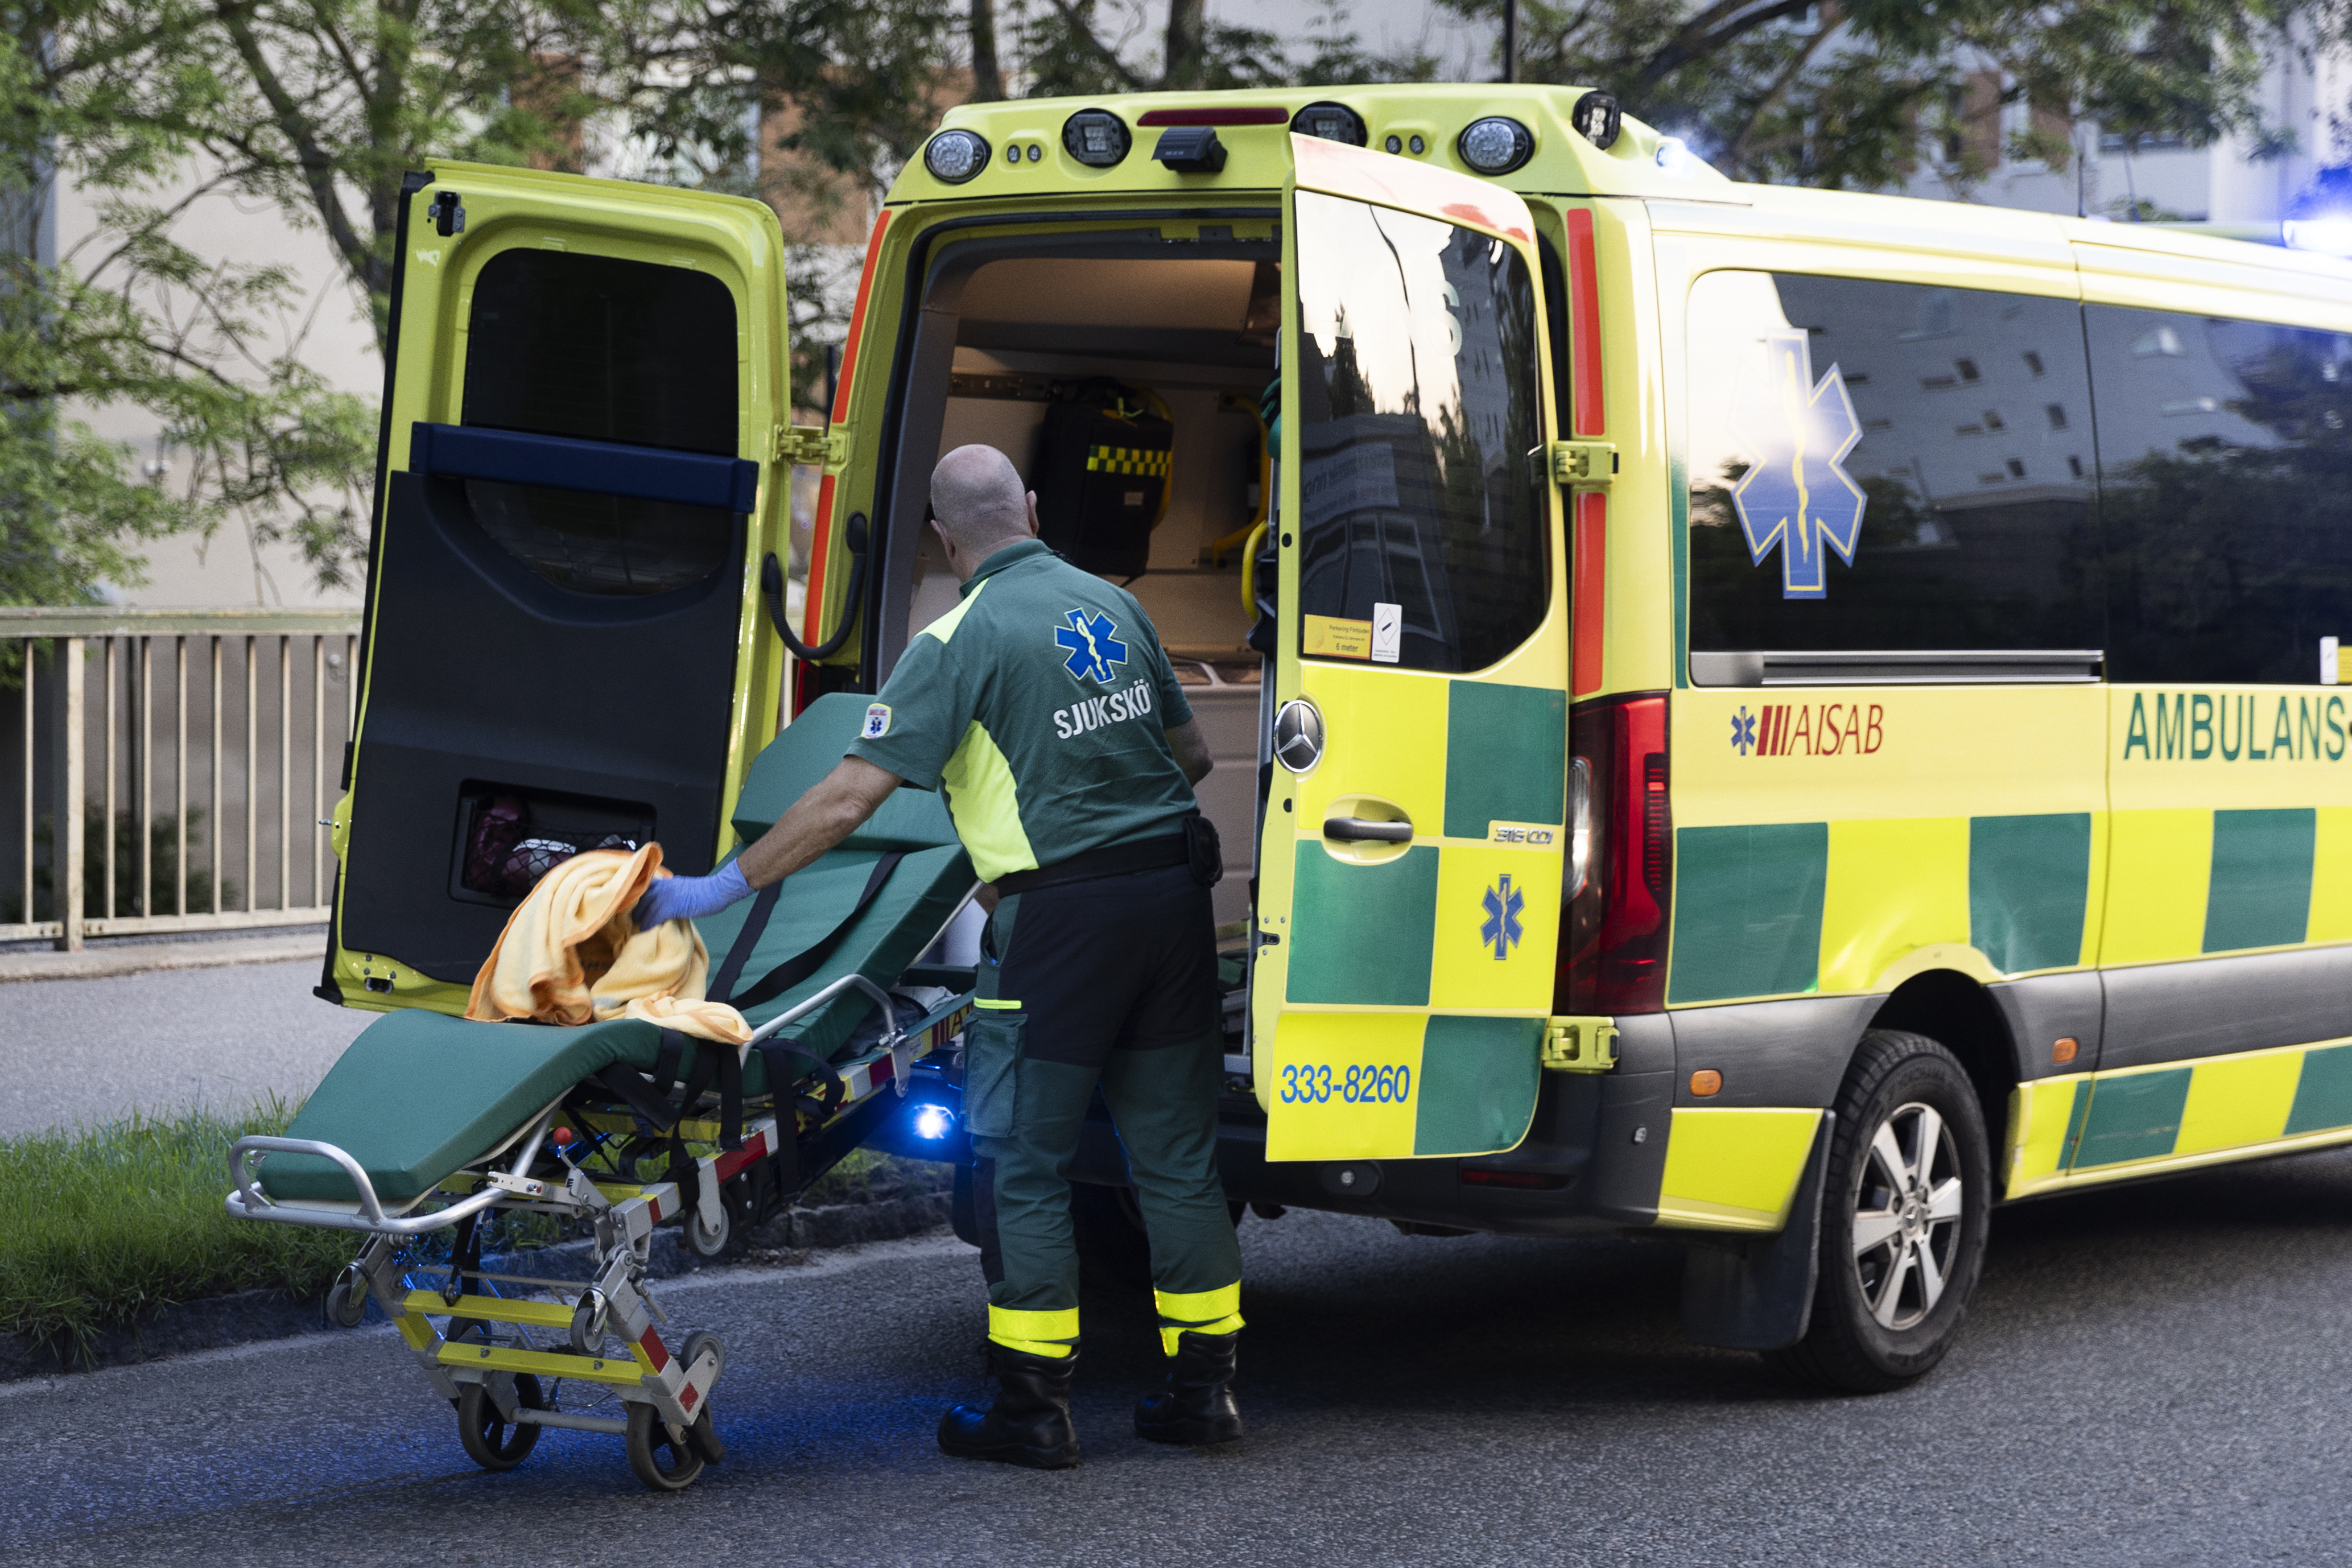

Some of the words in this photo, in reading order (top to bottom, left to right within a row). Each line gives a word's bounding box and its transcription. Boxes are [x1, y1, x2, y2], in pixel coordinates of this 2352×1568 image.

[1054, 679, 1151, 739] SJUKSKÖ
[1786, 704, 1883, 756] AISAB
[2123, 693, 2345, 761] AMBULANS
[1495, 827, 1526, 842] 316
[1527, 828, 1553, 844] CDI
[1280, 1064, 1410, 1104] 333-8260
